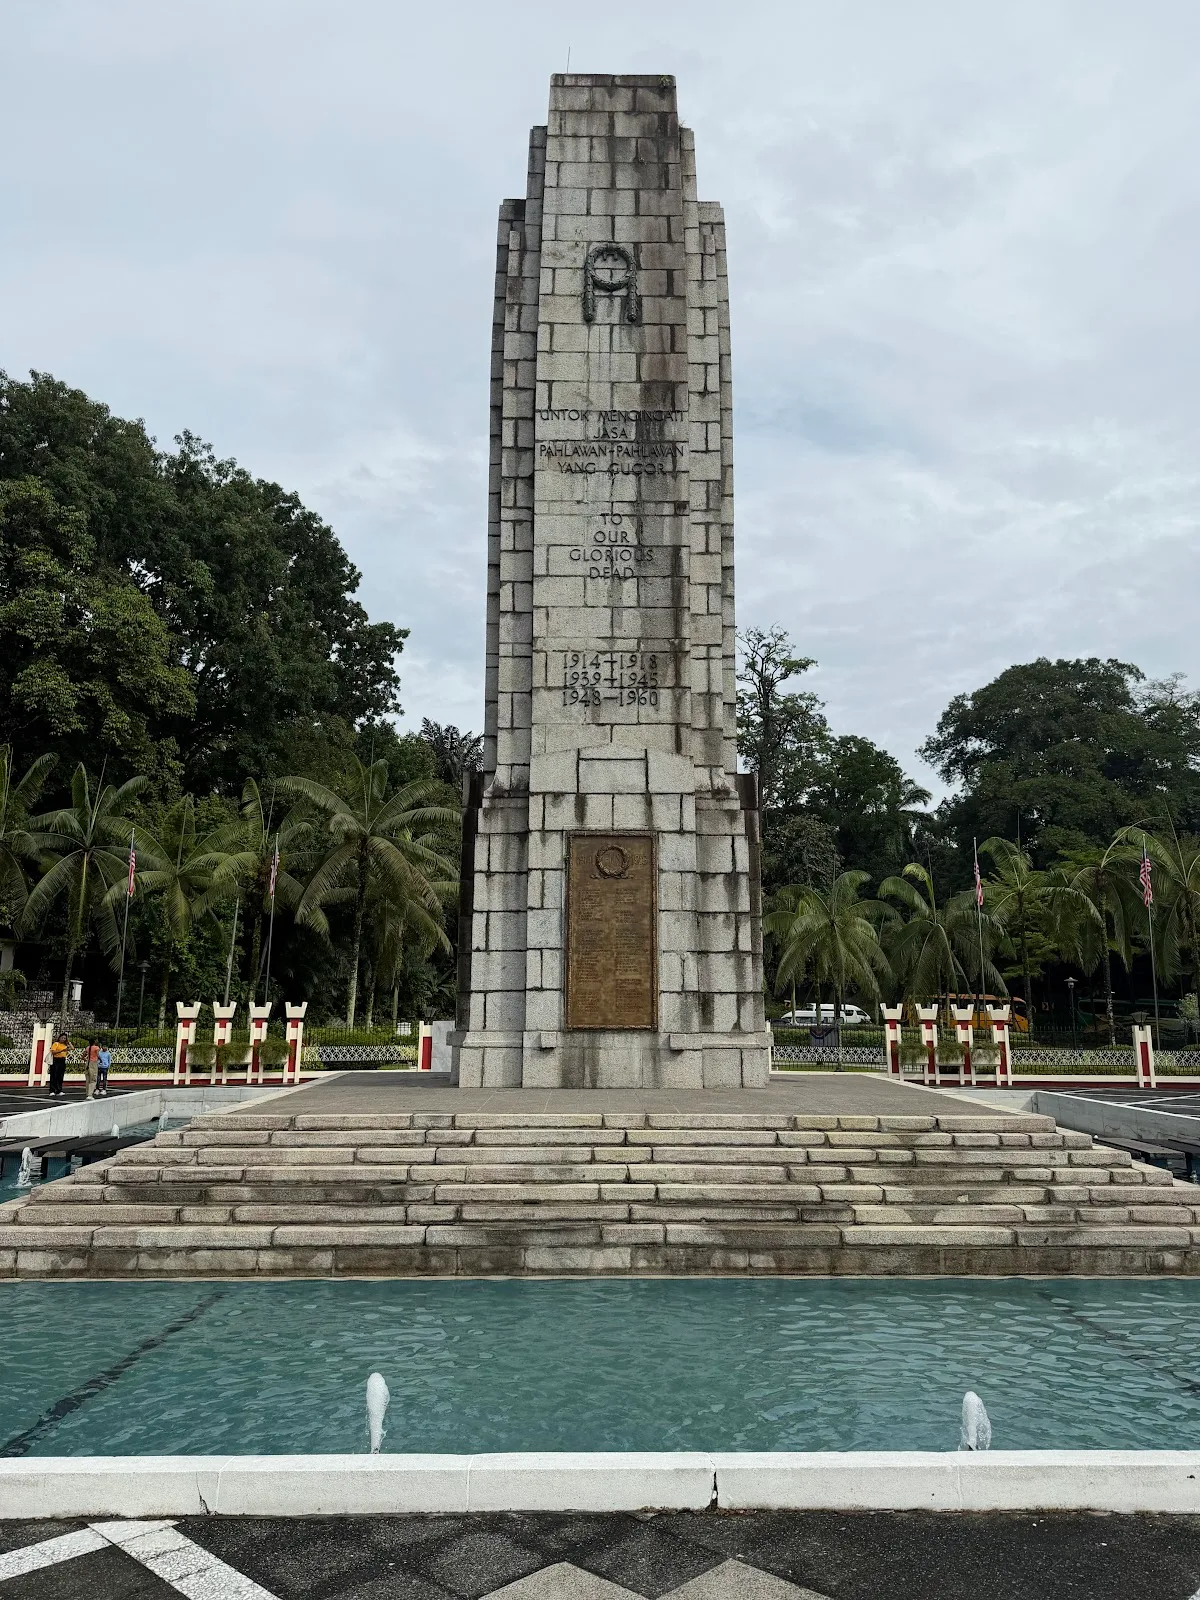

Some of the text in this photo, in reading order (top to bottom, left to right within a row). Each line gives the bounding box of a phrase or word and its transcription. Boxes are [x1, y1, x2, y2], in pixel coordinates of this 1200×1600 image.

[540, 409, 684, 422] UNTOK MENGINGATI
[593, 427, 629, 439] JASA
[539, 444, 684, 457] PAHLAWAN-PAHLAWAN
[558, 462, 667, 475] YANG GUGOR
[601, 513, 623, 525] TO
[593, 531, 630, 543] OUR
[569, 549, 654, 562] GLORIOUS
[589, 567, 635, 579] DEAD
